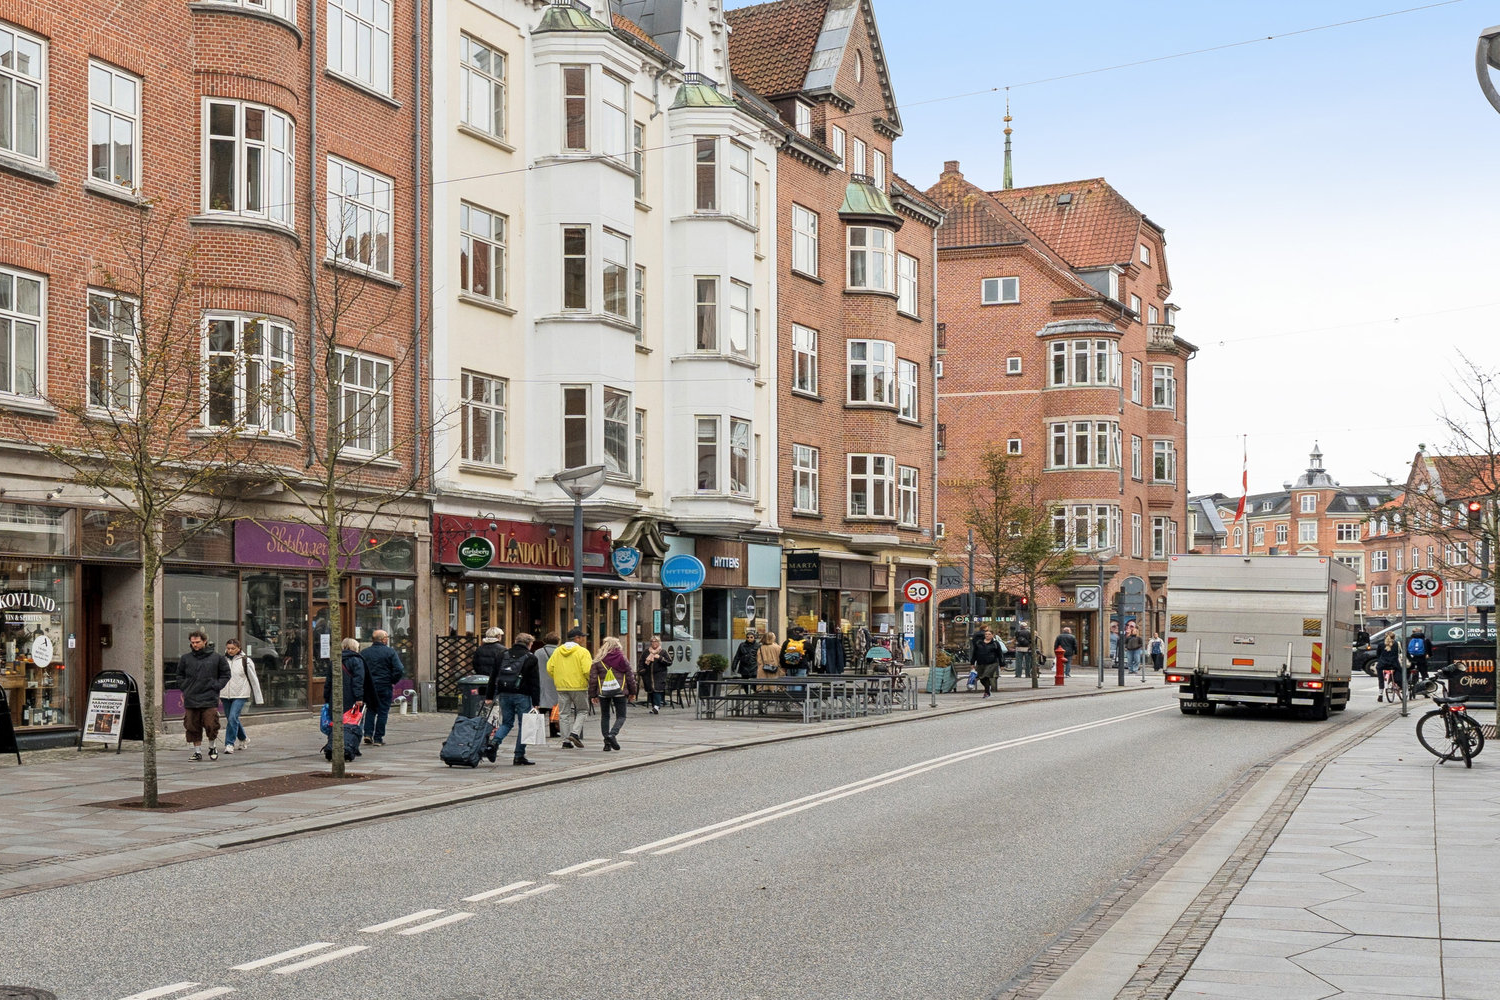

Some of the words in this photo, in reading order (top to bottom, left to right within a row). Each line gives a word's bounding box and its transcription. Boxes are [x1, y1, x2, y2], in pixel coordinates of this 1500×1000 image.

[105, 526, 115, 546] 5
[461, 547, 490, 558] Carlsberg
[547, 537, 570, 567] PUB
[713, 556, 740, 569] HYTTENS
[789, 562, 818, 570] MARTA
[1413, 579, 1436, 591] 30
[909, 586, 927, 597] 30
[1460, 676, 1488, 687] Open
